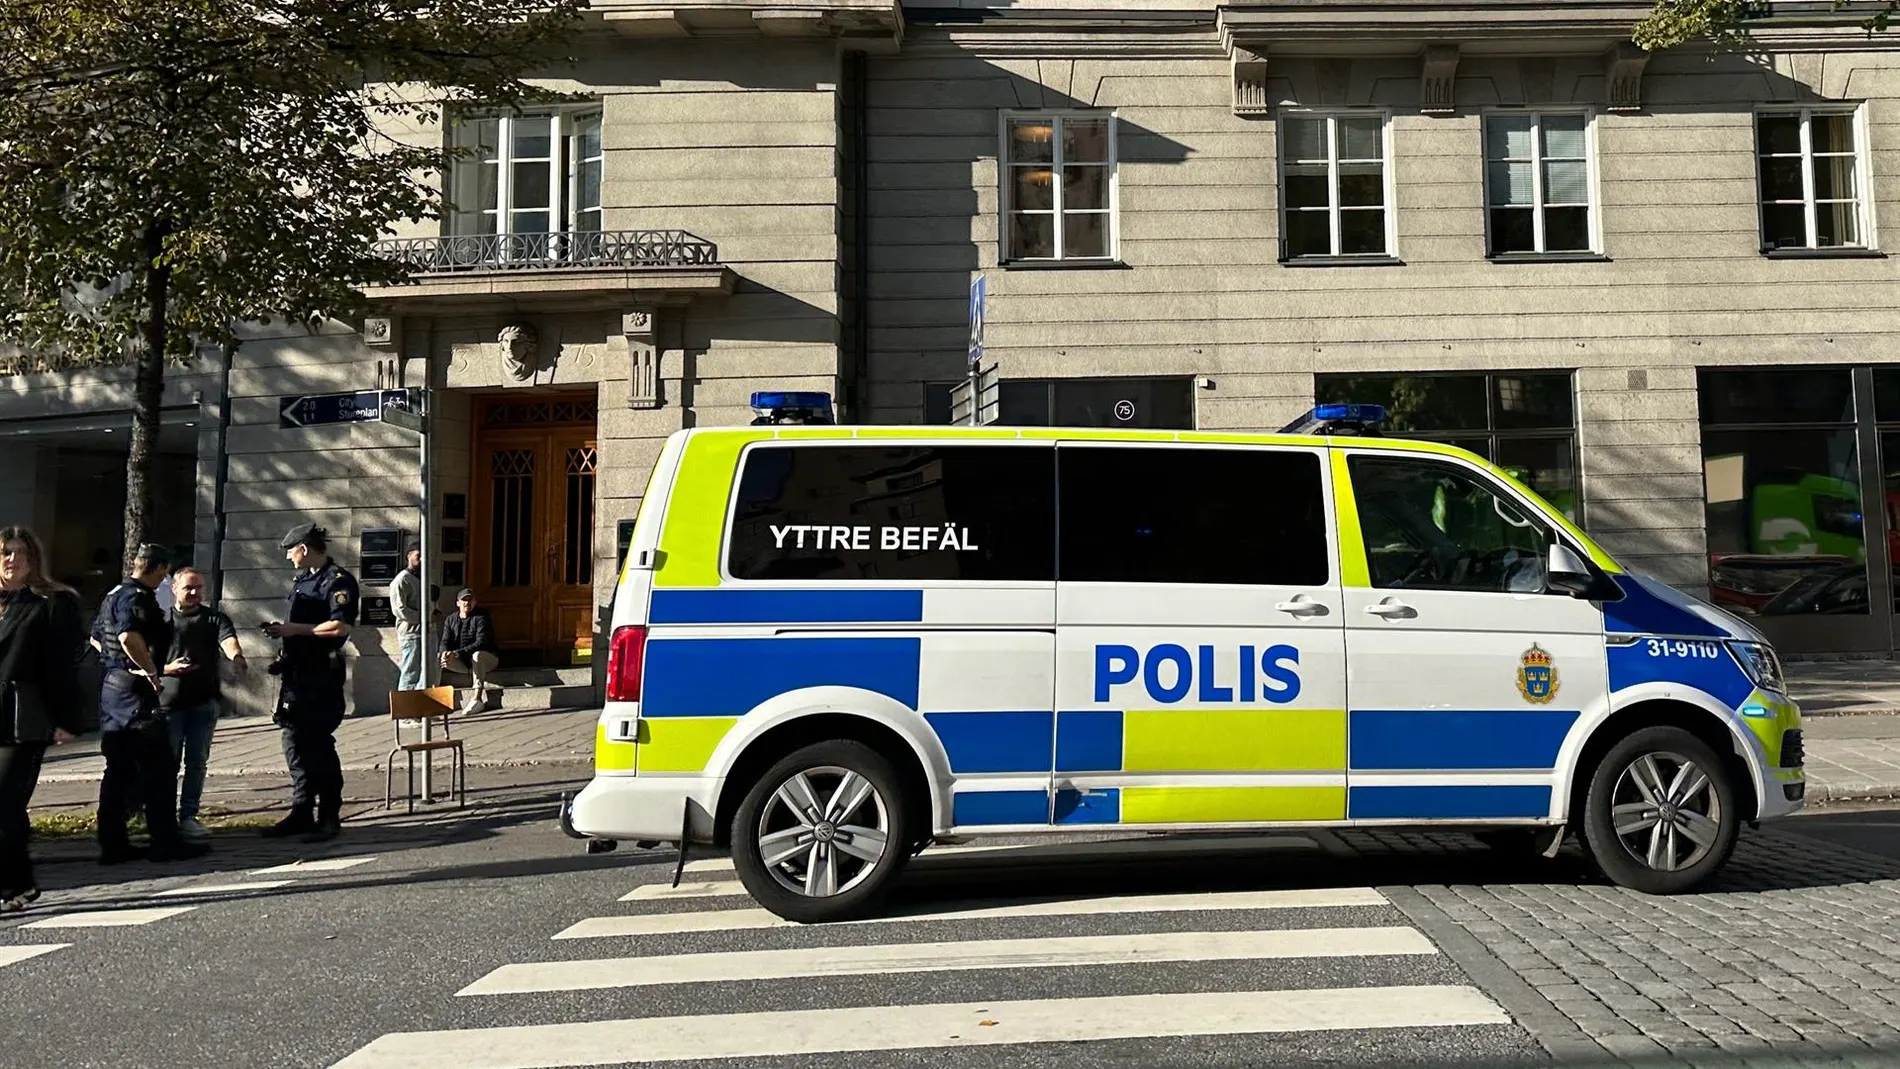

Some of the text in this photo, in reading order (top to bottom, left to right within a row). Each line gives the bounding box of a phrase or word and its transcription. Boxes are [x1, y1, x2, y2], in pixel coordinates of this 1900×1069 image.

[571, 344, 597, 368] 75
[338, 397, 354, 409] City
[338, 407, 378, 420] Stureplan
[769, 522, 979, 551] YTTRE BEFÄL
[1648, 639, 1719, 659] 31-9110
[1094, 643, 1301, 704] POLIS
